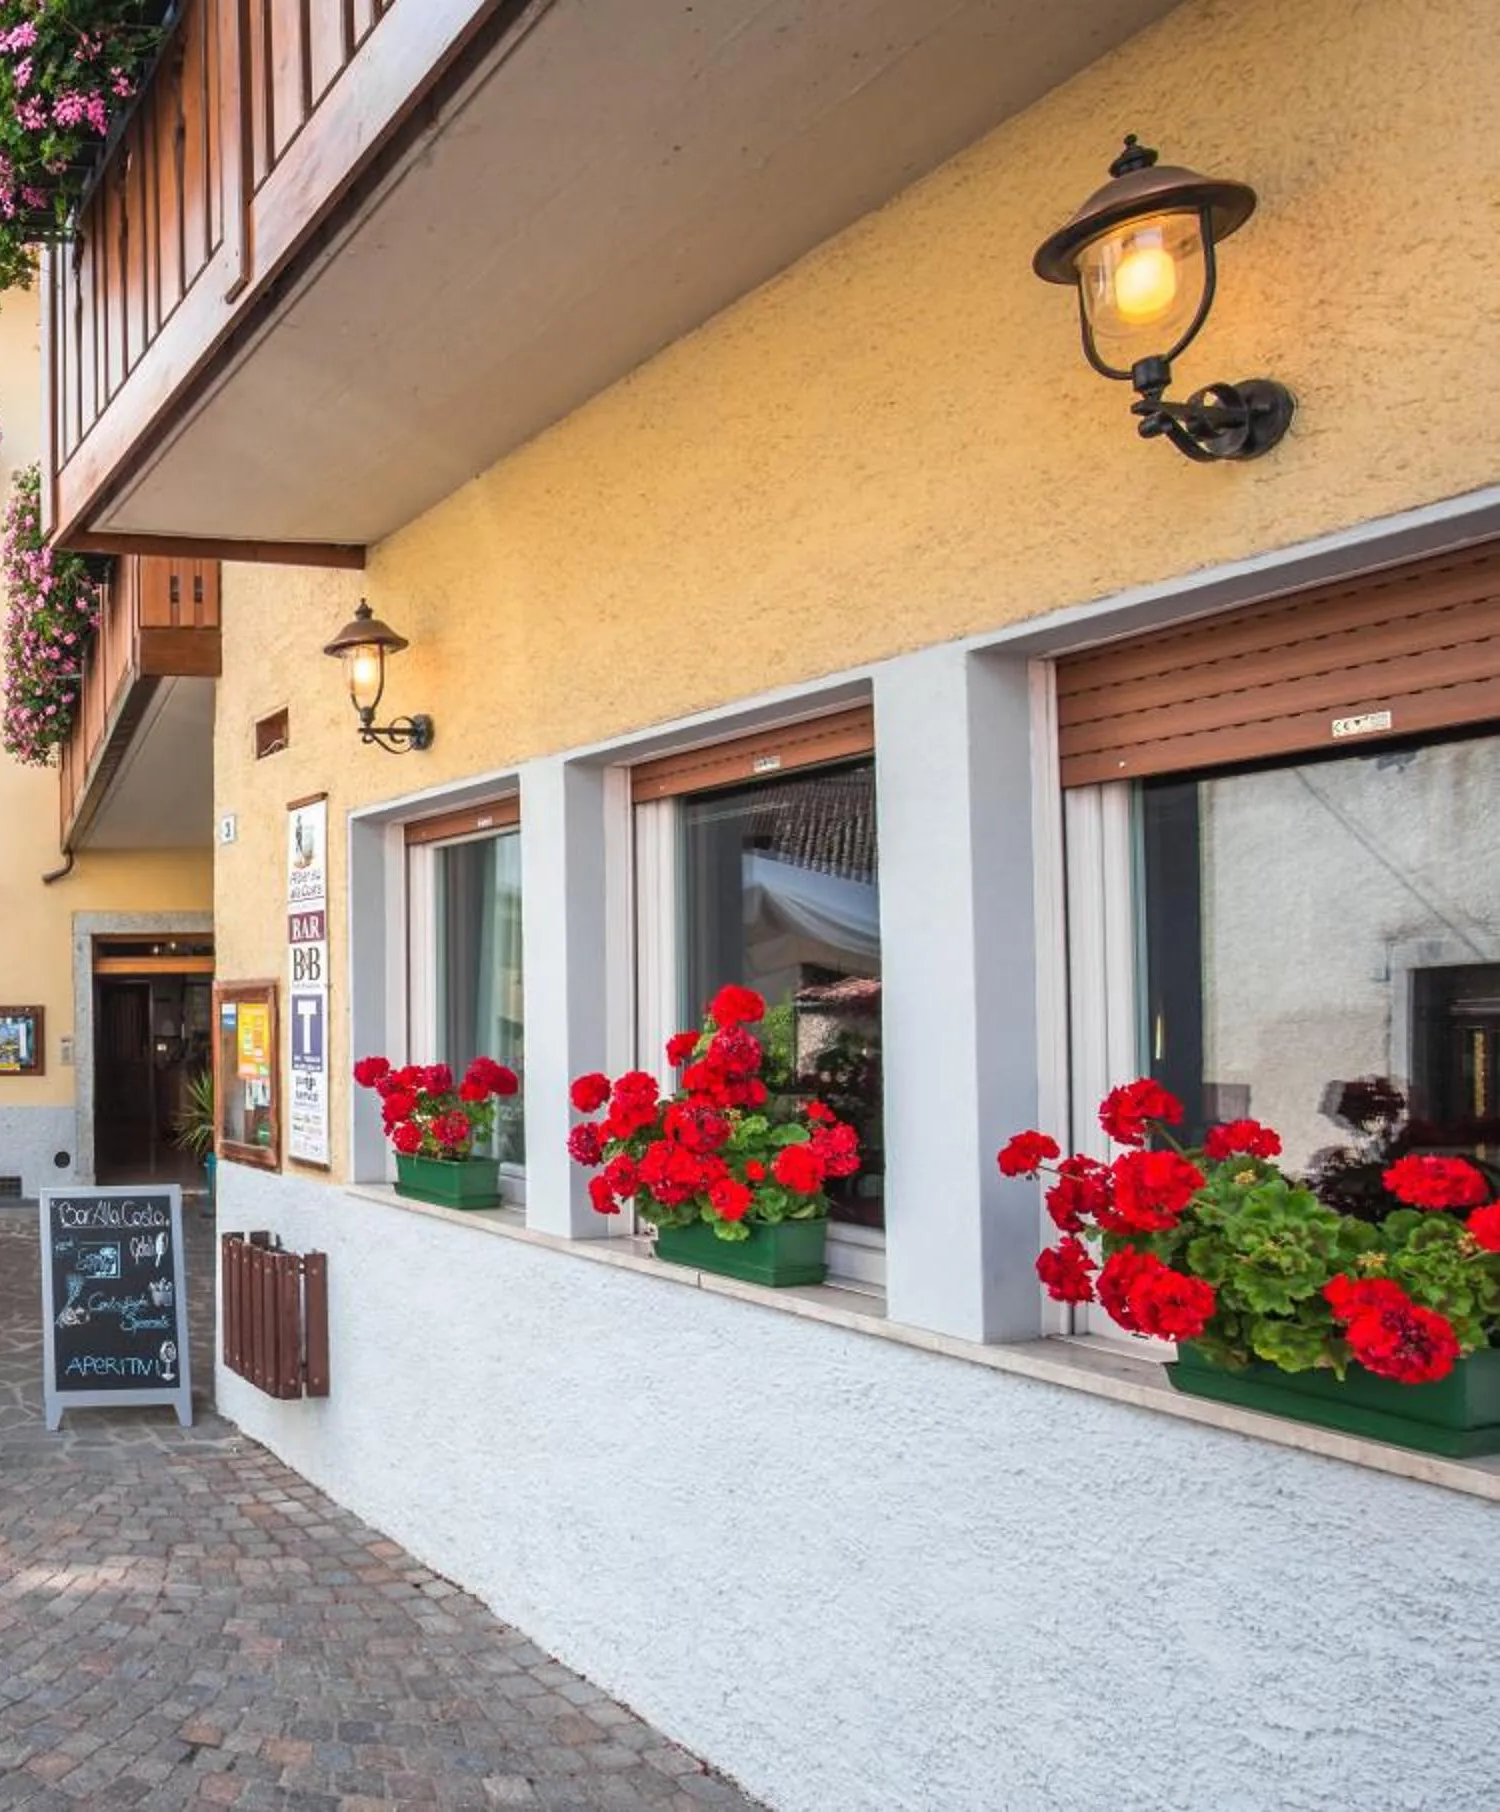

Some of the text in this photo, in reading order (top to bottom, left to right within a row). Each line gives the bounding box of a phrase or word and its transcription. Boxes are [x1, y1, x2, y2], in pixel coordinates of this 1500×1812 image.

[292, 915, 320, 940] BAR
[298, 1000, 317, 1054] T
[60, 1201, 92, 1227] Bar
[92, 1200, 120, 1226] Alla
